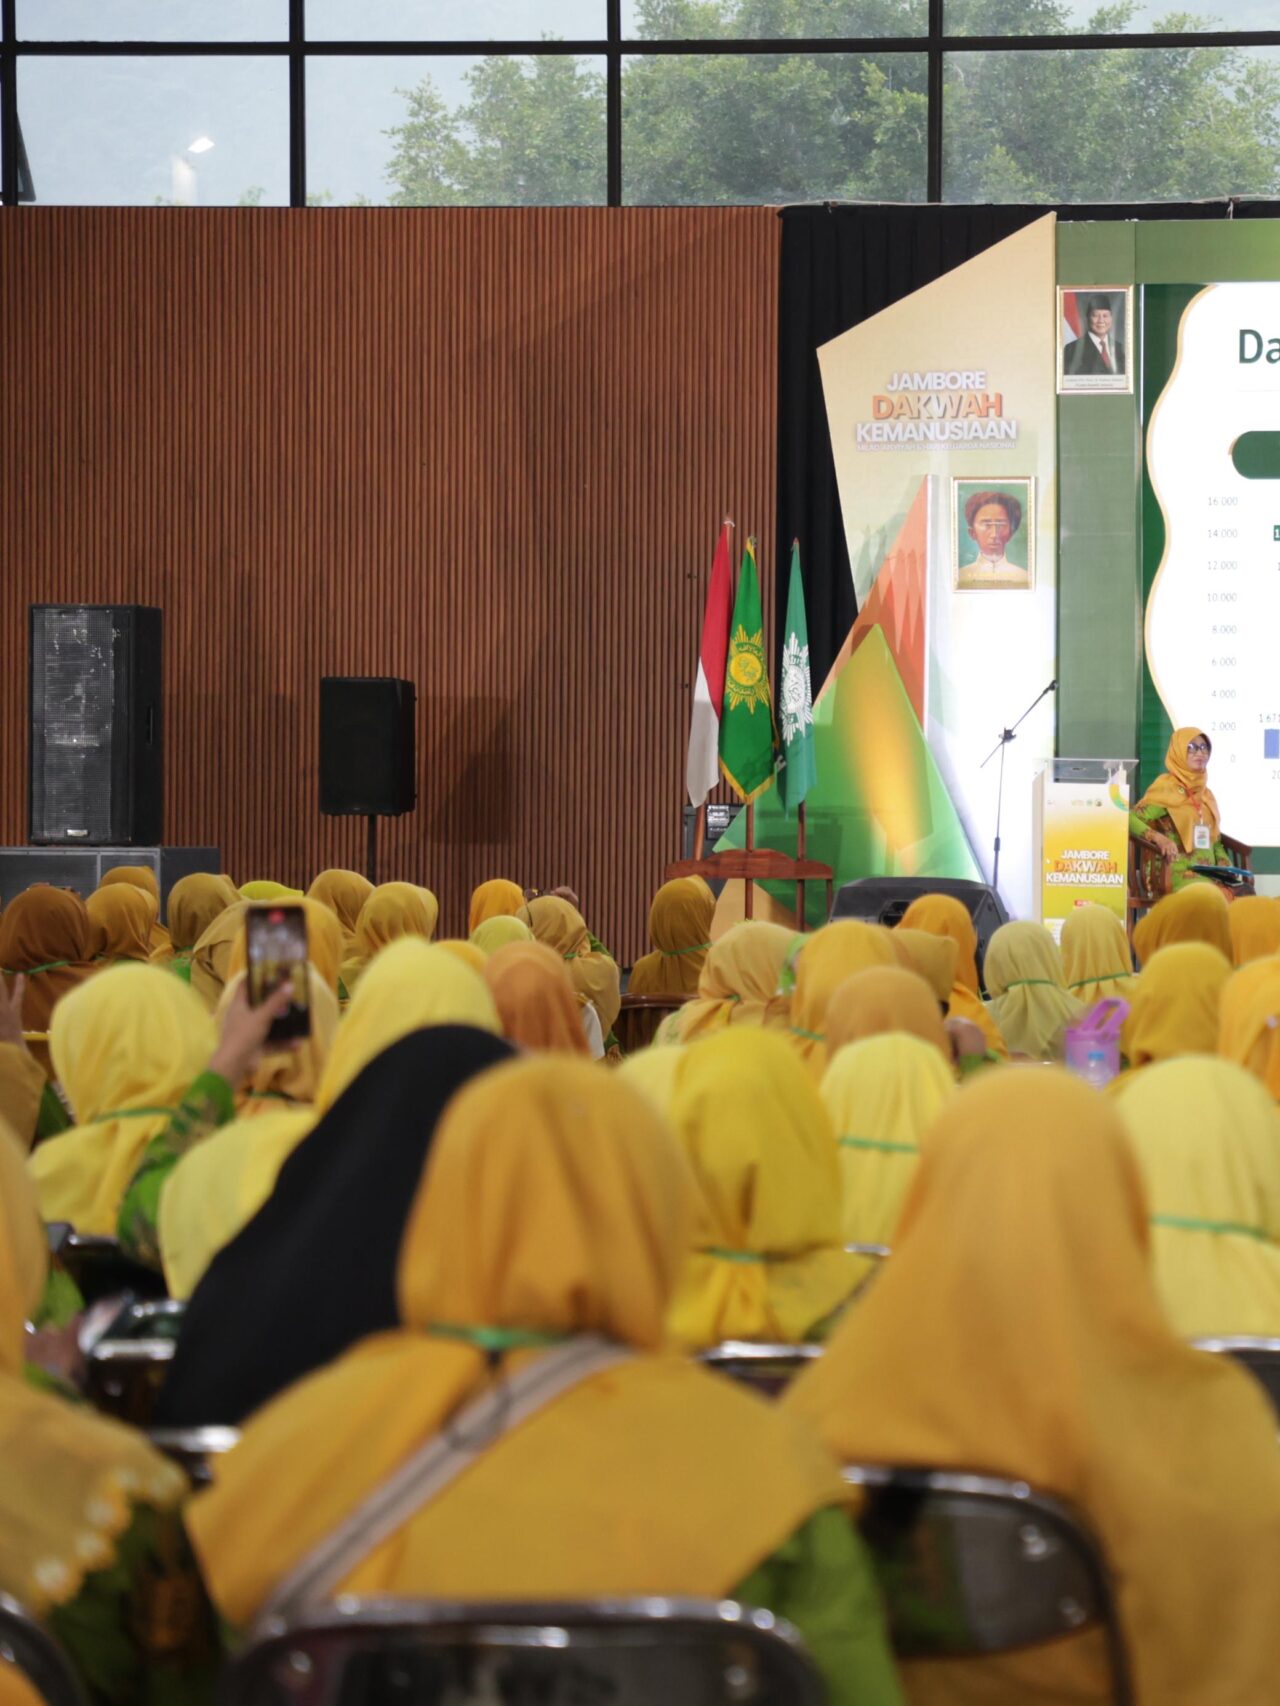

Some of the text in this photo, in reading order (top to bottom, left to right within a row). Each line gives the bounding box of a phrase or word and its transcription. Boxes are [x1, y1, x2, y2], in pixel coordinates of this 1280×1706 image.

[887, 372, 986, 390] JAMBORE
[872, 392, 1003, 419] DAKWAH
[857, 420, 1017, 441] KEMANUSIAAN
[1062, 850, 1109, 860] JAMBORE
[1054, 860, 1117, 873] DAKWAH
[1046, 873, 1123, 883] KEMANUSIAAN
